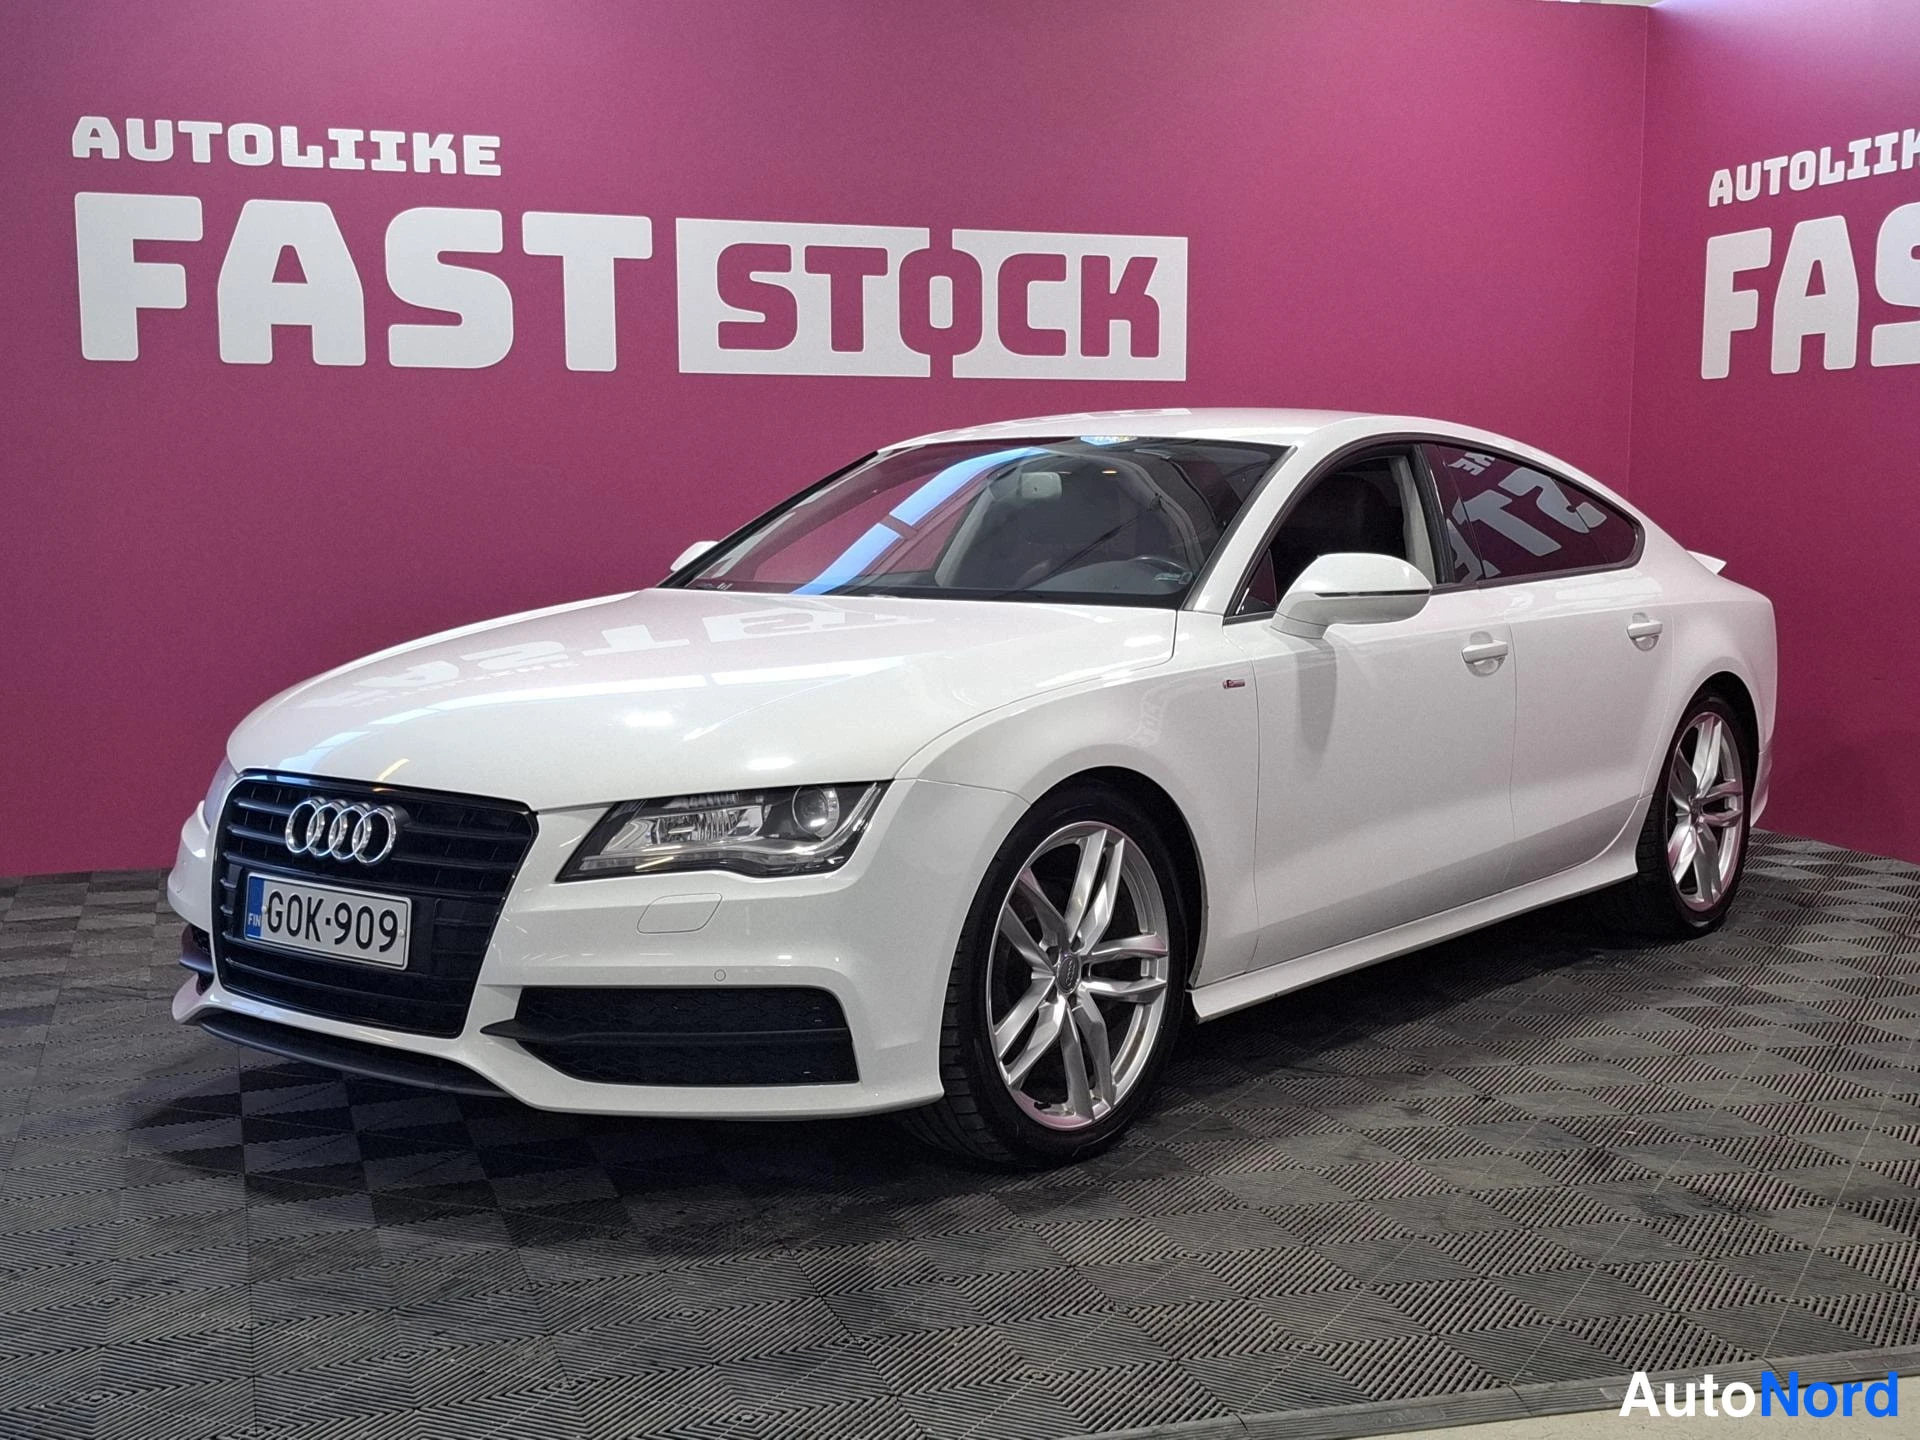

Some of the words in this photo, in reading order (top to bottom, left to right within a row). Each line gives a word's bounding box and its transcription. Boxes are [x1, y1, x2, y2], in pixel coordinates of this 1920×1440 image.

[72, 115, 502, 177] AUTOLIIKE
[74, 191, 653, 372] FAST
[715, 241, 1161, 359] STOCK
[247, 913, 262, 928] FIN
[267, 890, 399, 953] GOK-909
